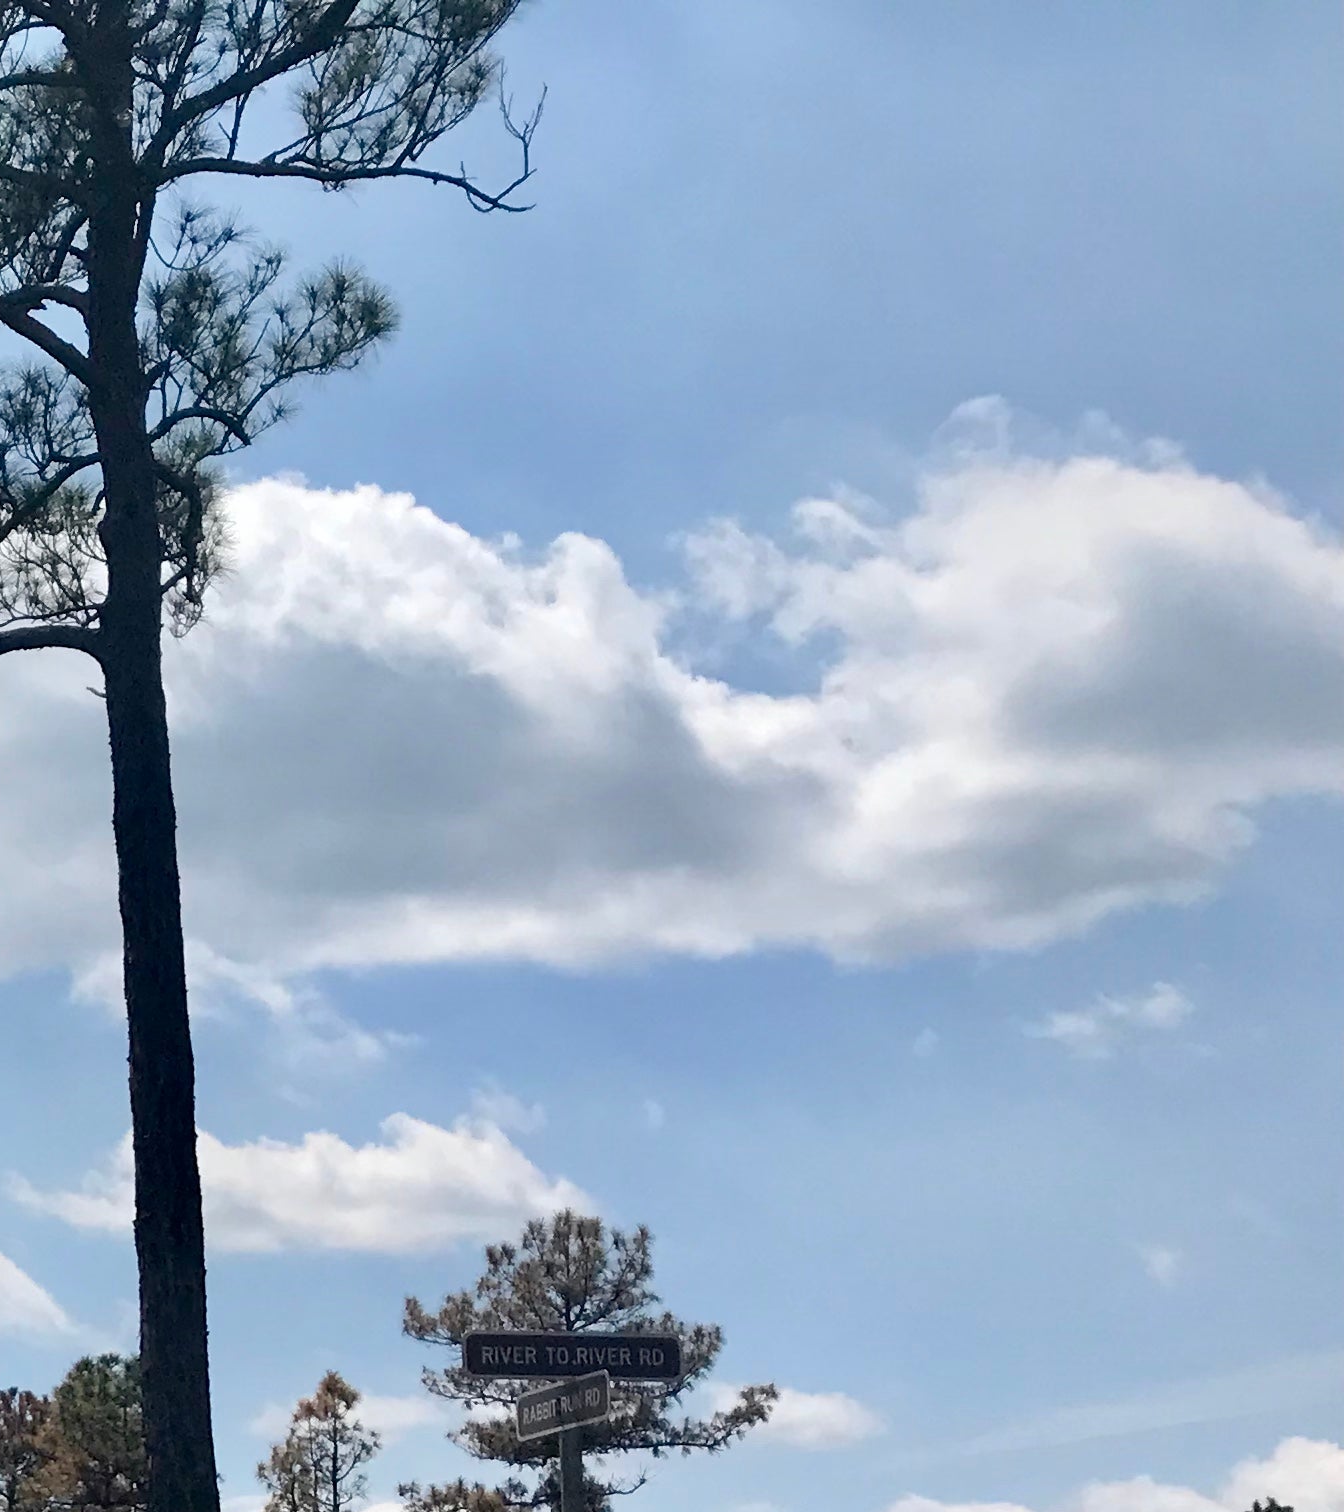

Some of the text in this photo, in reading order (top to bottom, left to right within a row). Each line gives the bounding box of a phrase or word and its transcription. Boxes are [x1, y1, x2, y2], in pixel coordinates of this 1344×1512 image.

[482, 1346, 665, 1367] RIVER TO RIVER RD
[523, 1400, 557, 1425] RABBIT
[585, 1388, 600, 1407] RD
